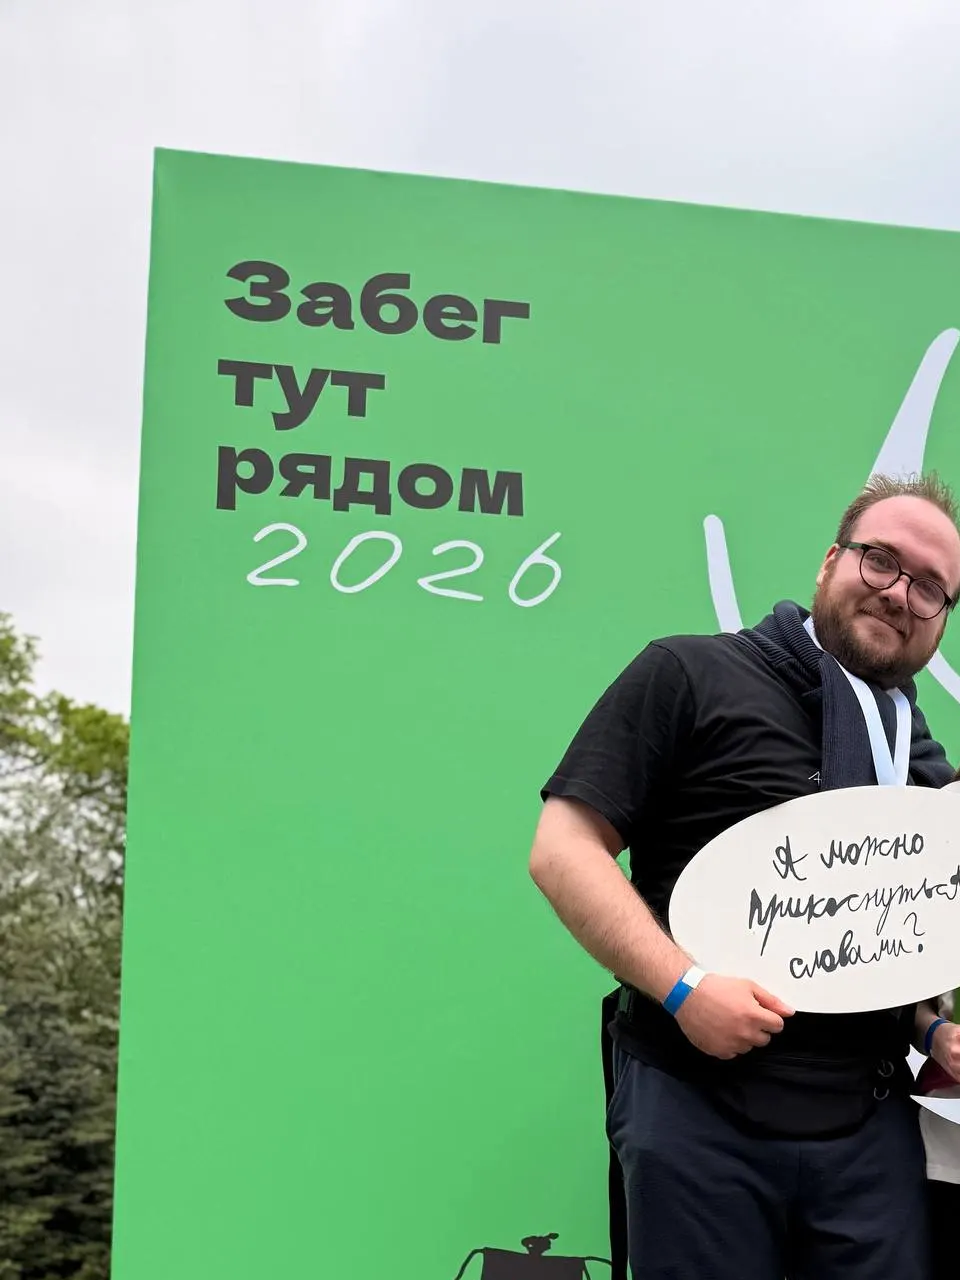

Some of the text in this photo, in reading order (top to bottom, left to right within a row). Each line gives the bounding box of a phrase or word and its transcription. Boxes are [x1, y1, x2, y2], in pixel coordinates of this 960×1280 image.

[223, 260, 531, 344] Забег
[217, 358, 386, 431] тут
[216, 445, 524, 517] рядом
[246, 522, 562, 608] 2026
[820, 833, 924, 869] можно
